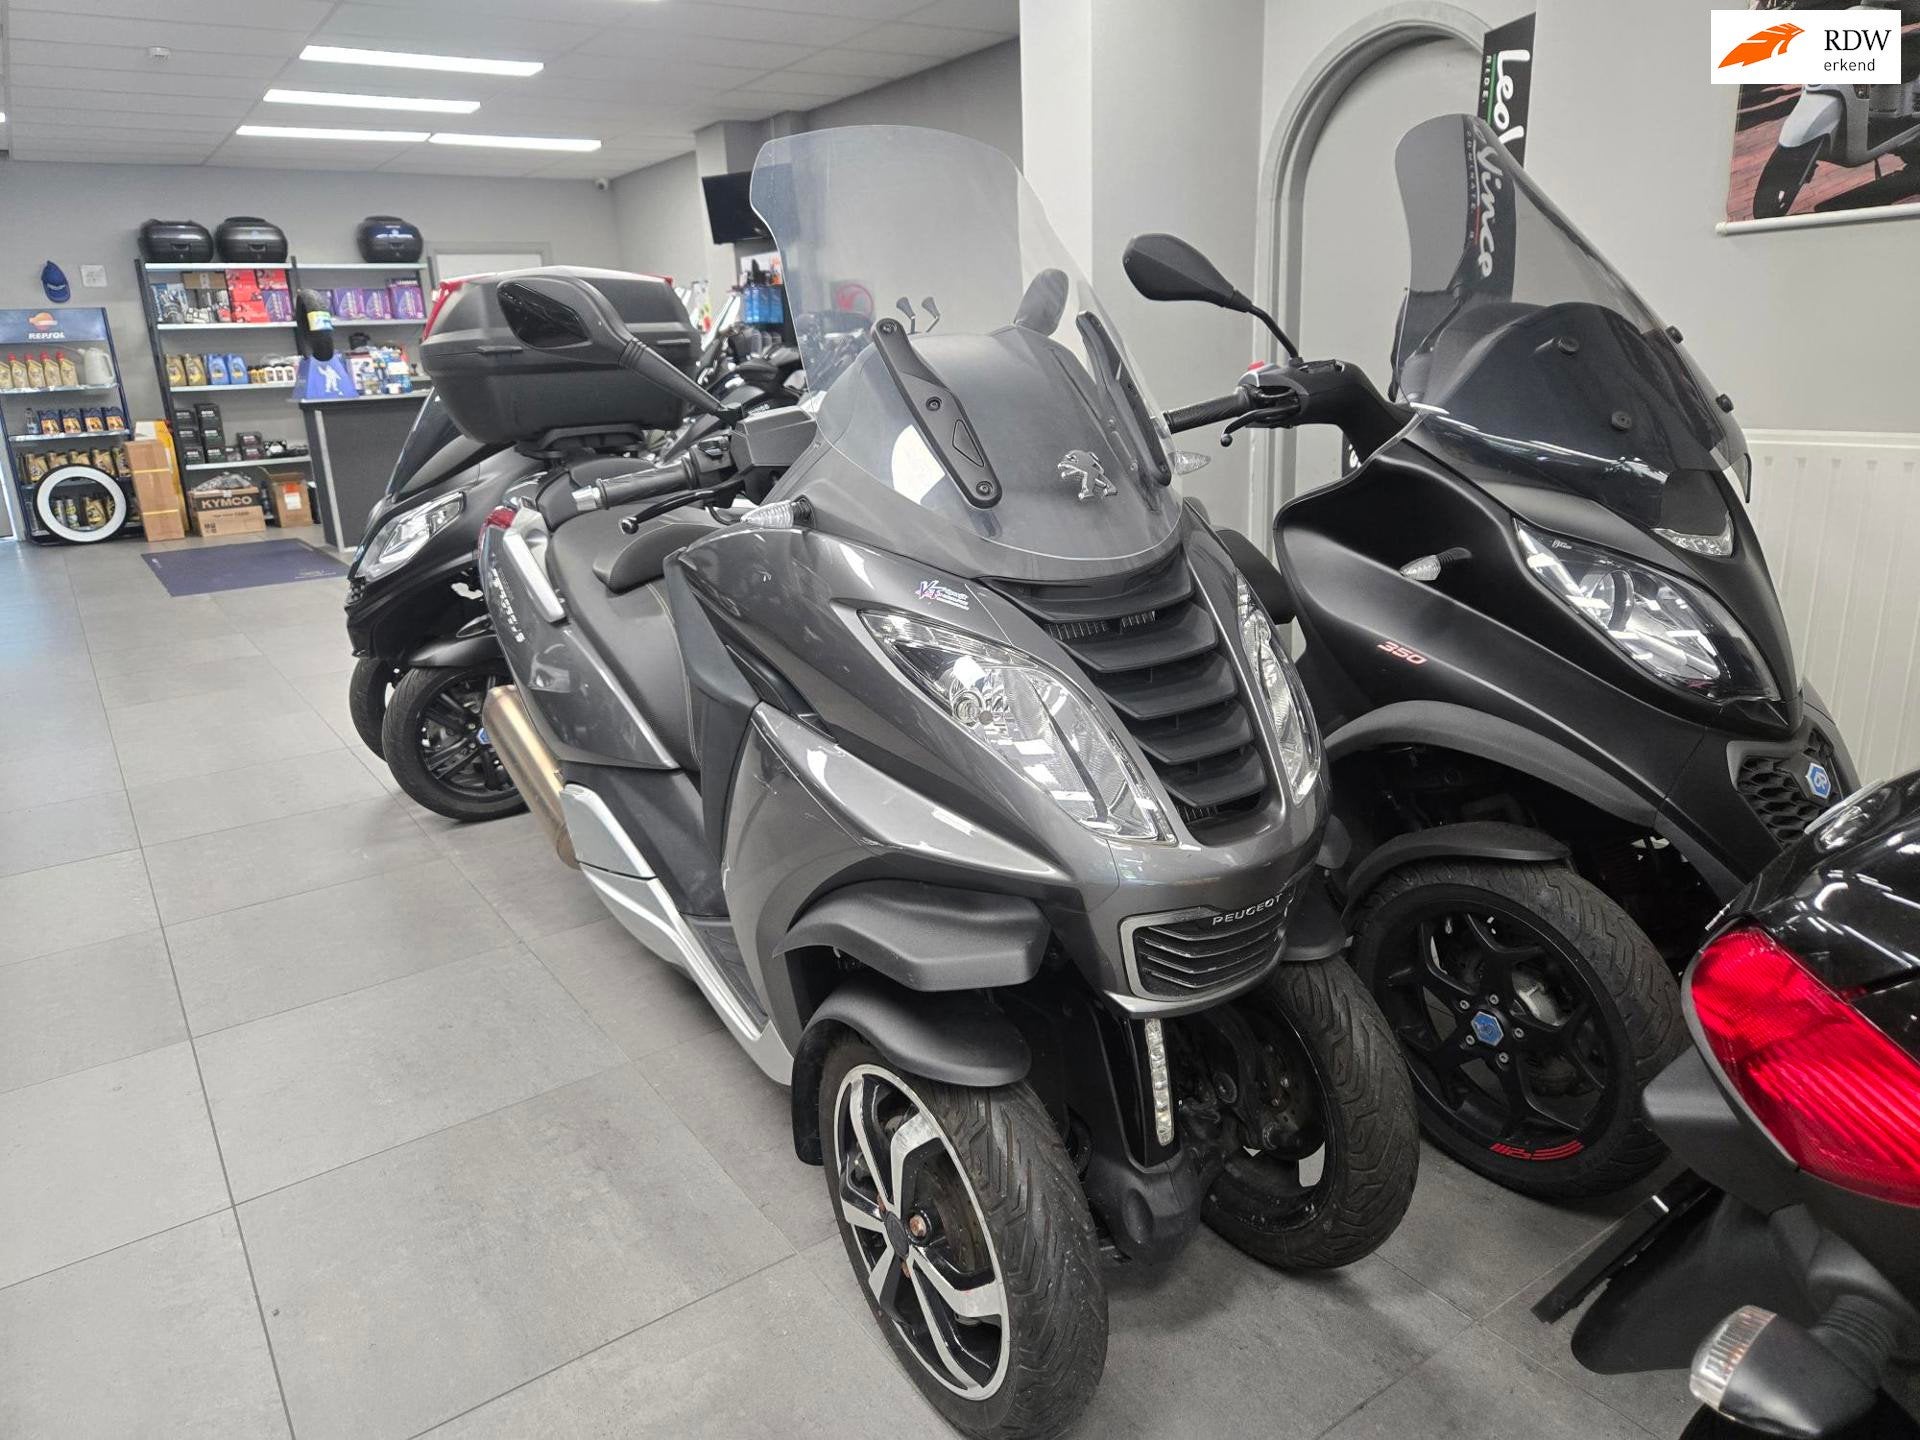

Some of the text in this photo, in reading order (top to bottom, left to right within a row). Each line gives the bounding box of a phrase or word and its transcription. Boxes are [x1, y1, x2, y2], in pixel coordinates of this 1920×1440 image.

[28, 331, 65, 340] REPSOL
[201, 495, 252, 509] KYMCO
[1376, 641, 1428, 665] 350
[1212, 893, 1283, 925] PEUGEOT
